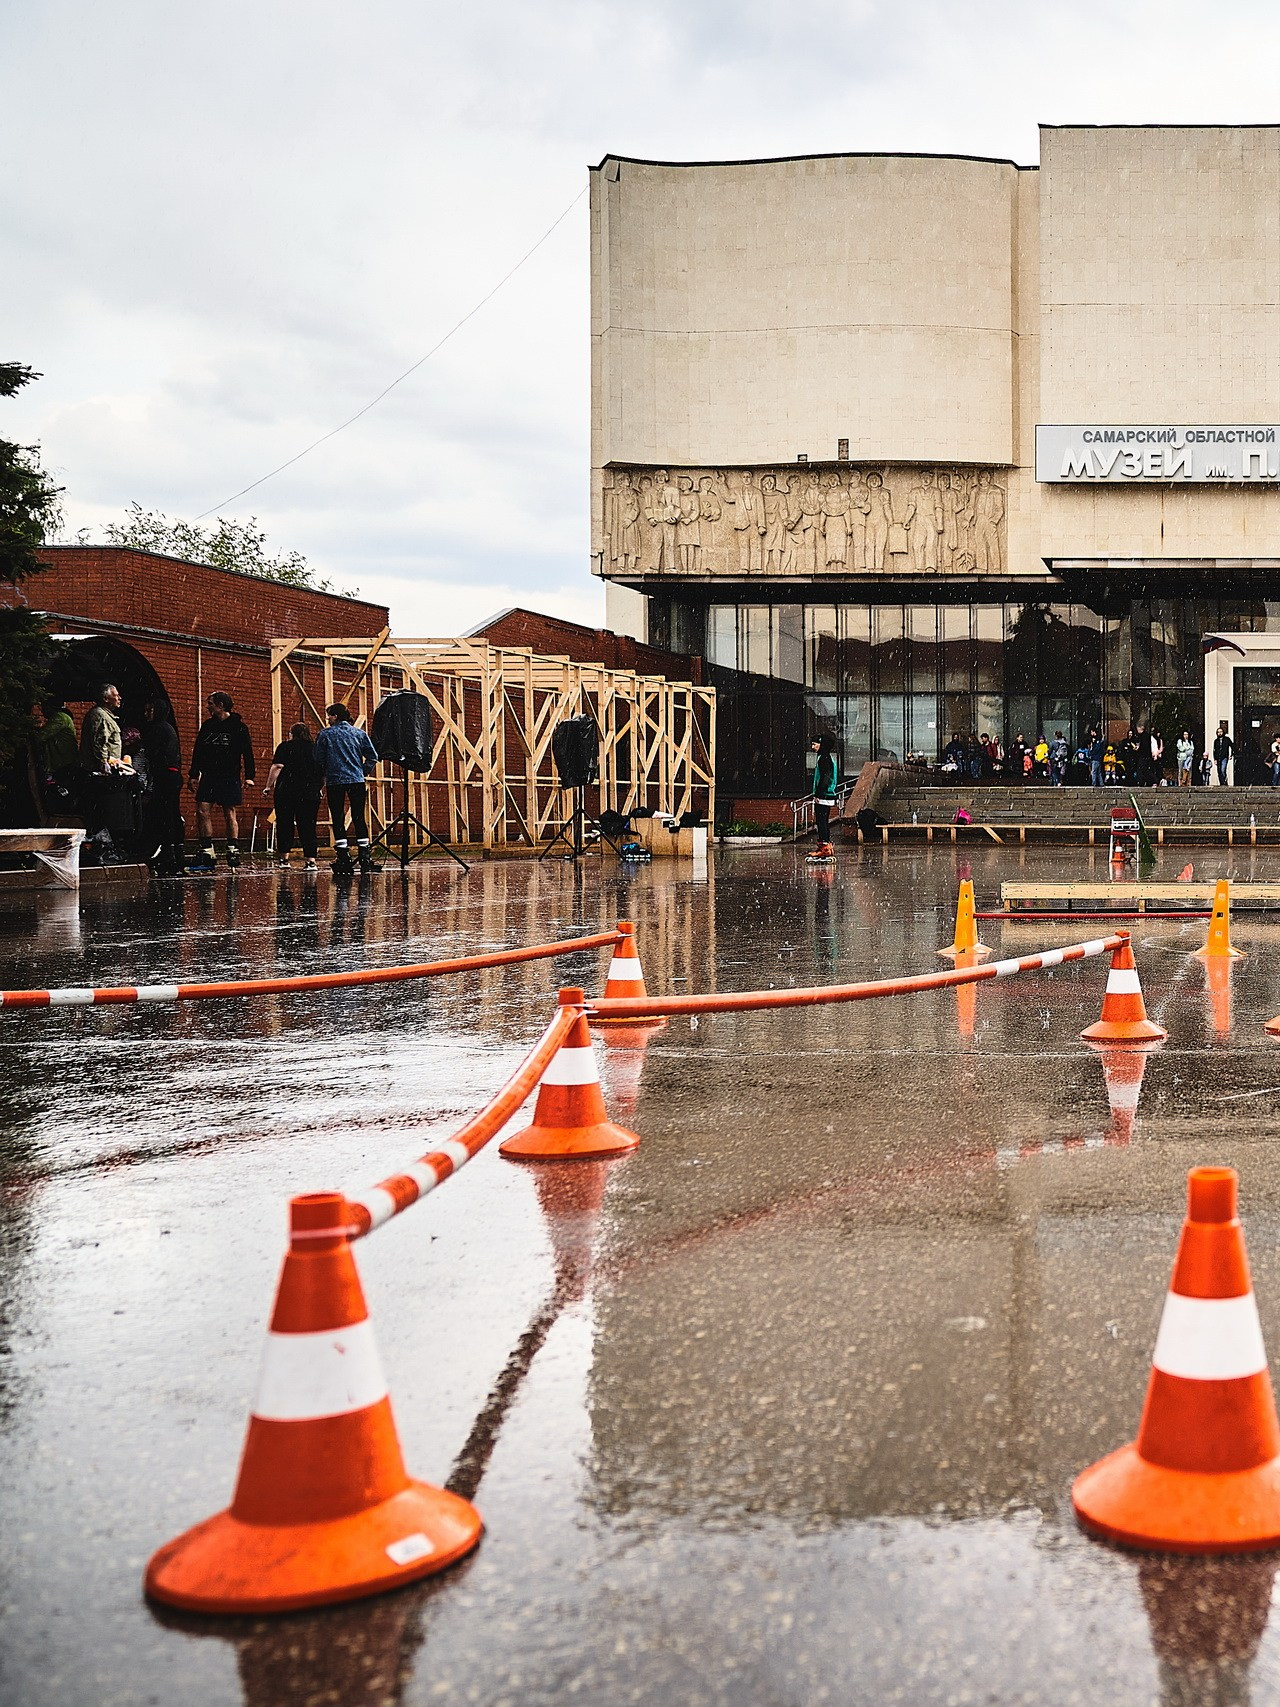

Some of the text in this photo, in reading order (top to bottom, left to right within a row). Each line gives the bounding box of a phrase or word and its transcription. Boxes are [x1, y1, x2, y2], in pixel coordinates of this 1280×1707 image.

[1082, 428, 1177, 443] САМАРСКИЙ
[1185, 428, 1276, 443] ОБЛАСТНОЙ
[1060, 442, 1193, 478] МУЗЕЙ
